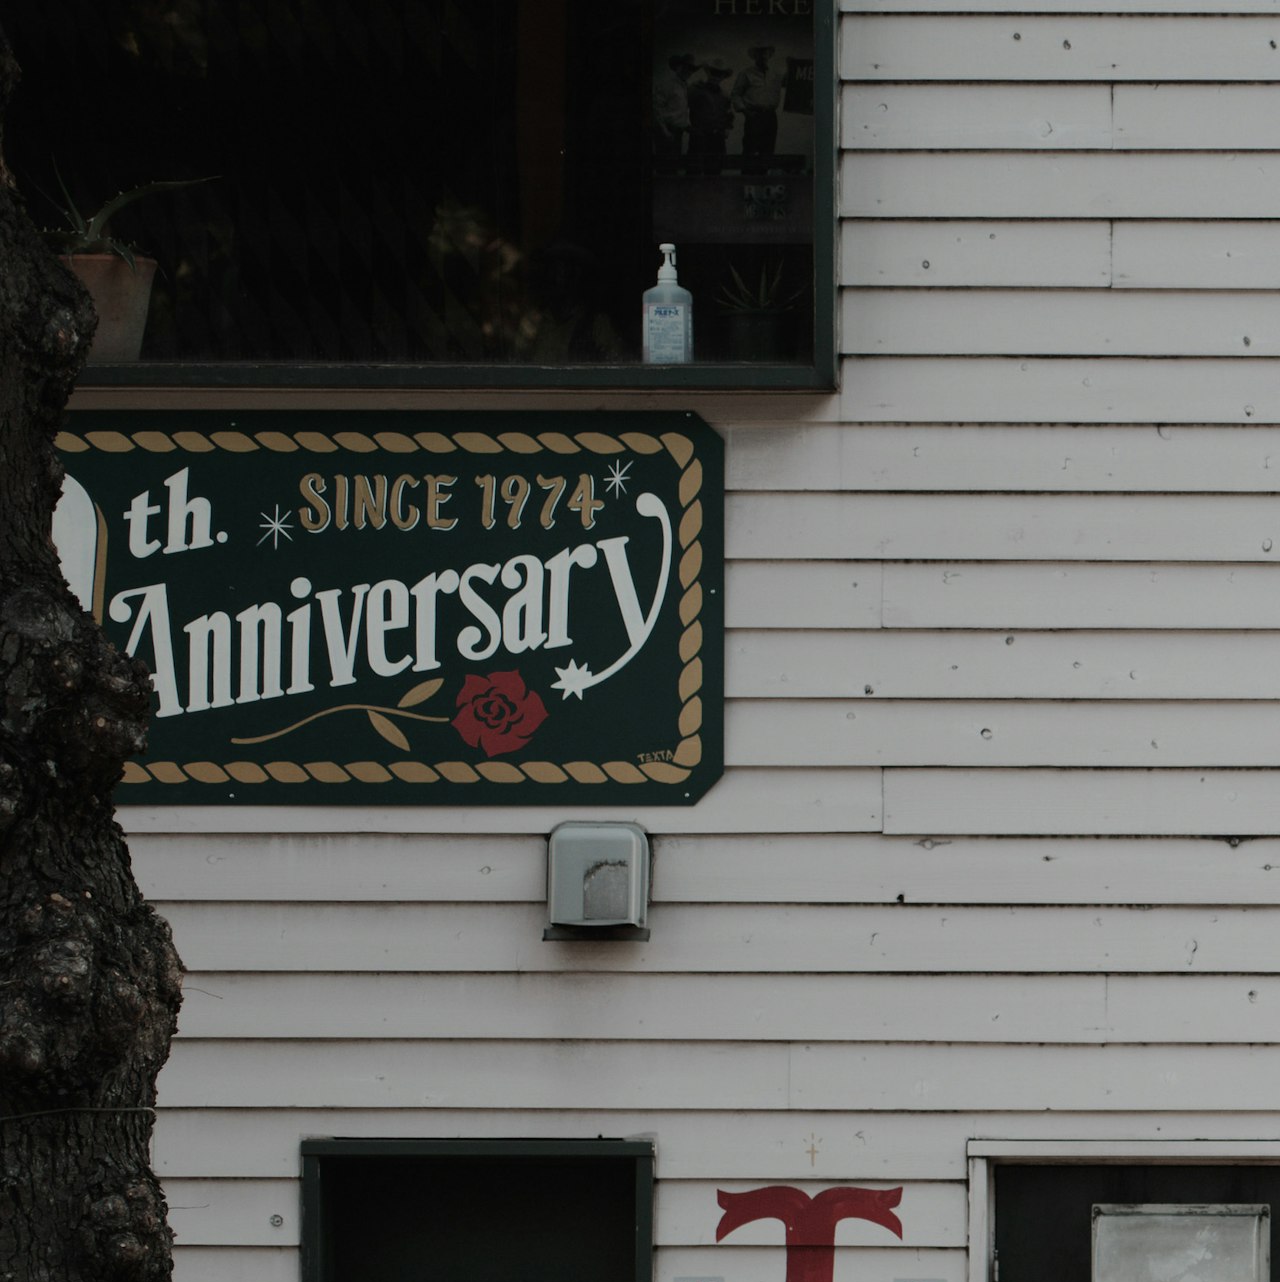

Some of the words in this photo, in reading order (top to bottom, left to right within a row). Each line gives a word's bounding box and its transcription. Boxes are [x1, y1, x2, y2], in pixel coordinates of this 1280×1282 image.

[299, 474, 459, 531] SINCE
[475, 474, 605, 530] 1974
[109, 493, 672, 718] Anniversary
